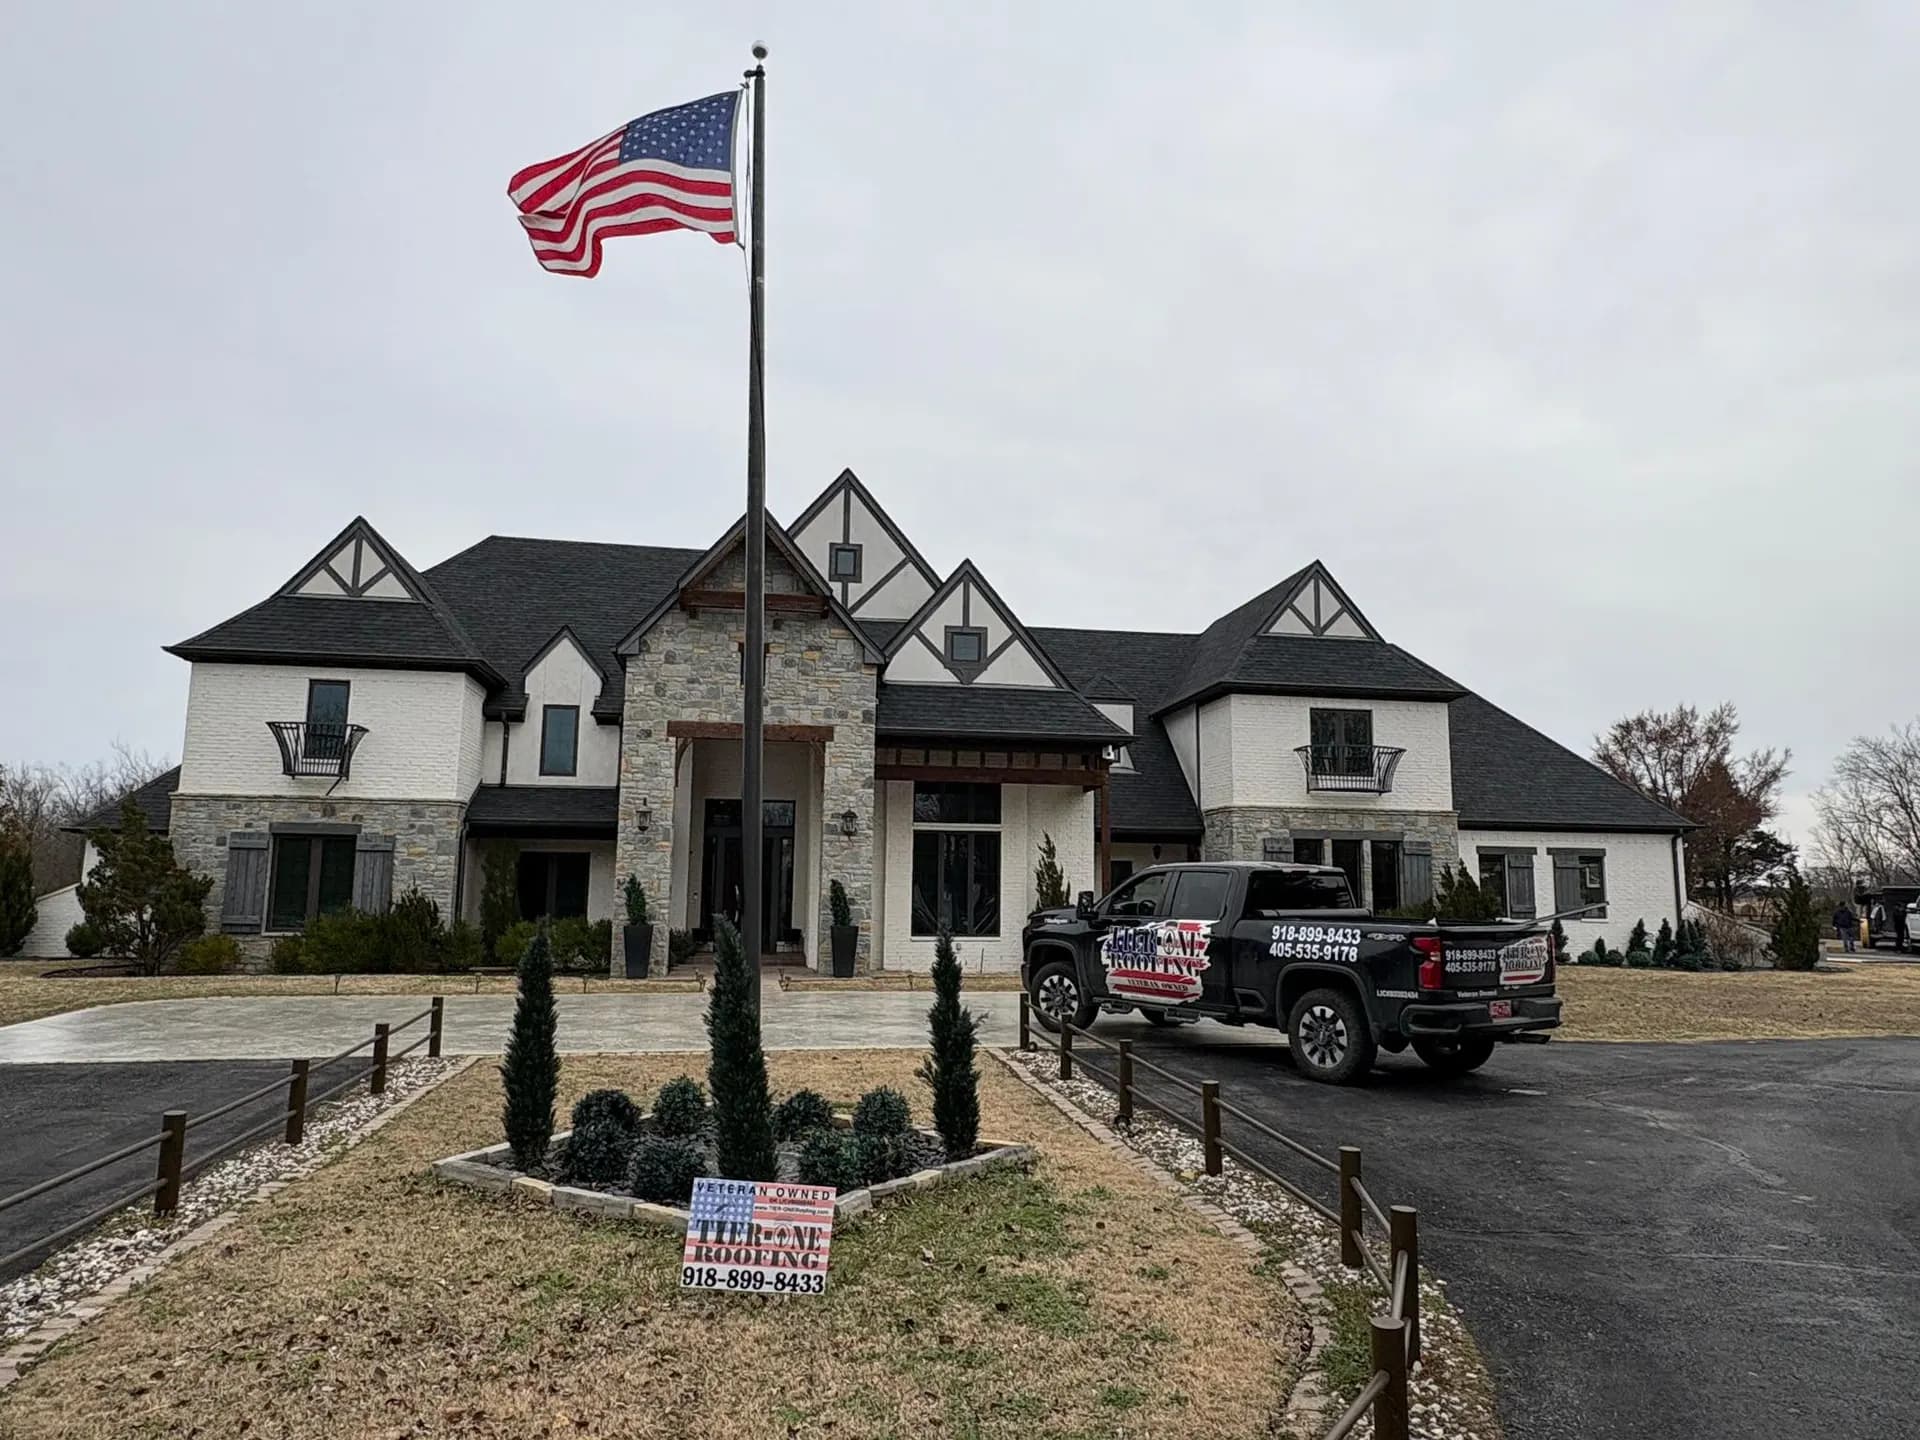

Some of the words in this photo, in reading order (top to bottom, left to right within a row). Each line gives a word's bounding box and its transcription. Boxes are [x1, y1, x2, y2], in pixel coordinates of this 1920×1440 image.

[1271, 925, 1361, 944] 918-899-8433
[1269, 942, 1358, 962] 405-535-9178
[1445, 961, 1497, 973] 405-535-9178
[695, 1182, 767, 1196] VETERAN
[776, 1187, 830, 1200] OWNED
[693, 1246, 820, 1269] ROOFING
[683, 1266, 824, 1293] 918-899-8433
